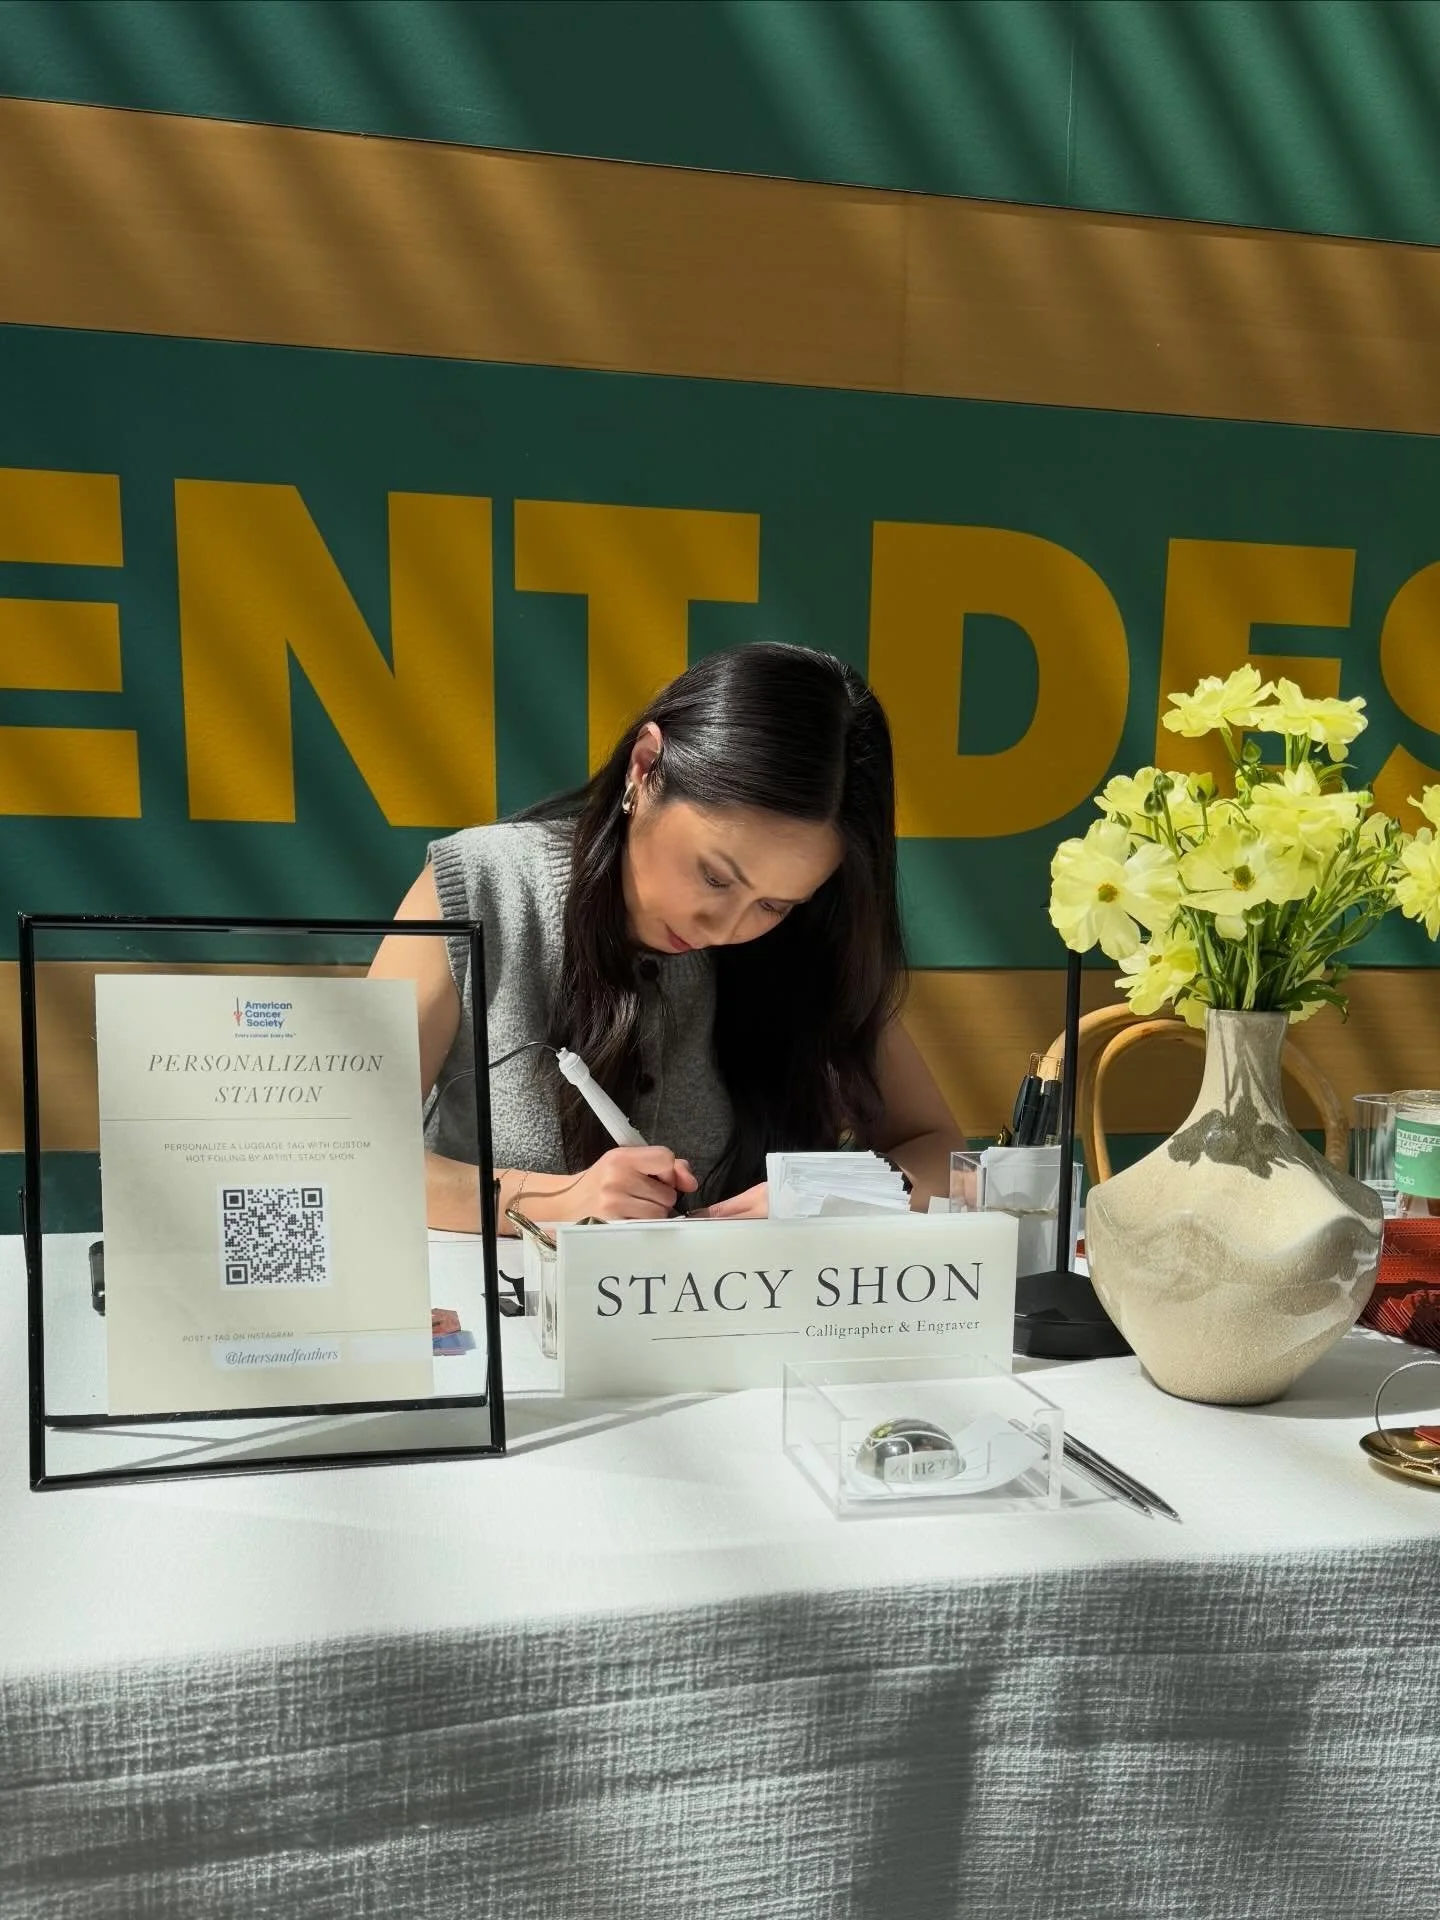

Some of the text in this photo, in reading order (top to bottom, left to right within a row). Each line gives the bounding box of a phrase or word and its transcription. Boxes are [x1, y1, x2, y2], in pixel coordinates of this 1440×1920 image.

[245, 1001, 293, 1010] American
[245, 1010, 281, 1018] Cancer
[246, 1018, 285, 1028] Society
[148, 1053, 384, 1073] PERSONALIZATION
[214, 1085, 323, 1104] STATION
[164, 1140, 371, 1151] PERSONALIZE A LUGGAGE TAG WITH CUSTOM
[184, 1154, 204, 1163] HOT
[208, 1153, 246, 1162] FOILING
[248, 1153, 260, 1162] BY
[596, 1261, 984, 1317] STACY SHON
[805, 1319, 981, 1340] Calligrapher & Engraver
[183, 1335, 204, 1343] POST
[214, 1334, 230, 1342] TAG
[232, 1332, 246, 1341] ON
[247, 1331, 294, 1340] INSTAGRAM
[225, 1348, 338, 1365] @lettersandfeathers
